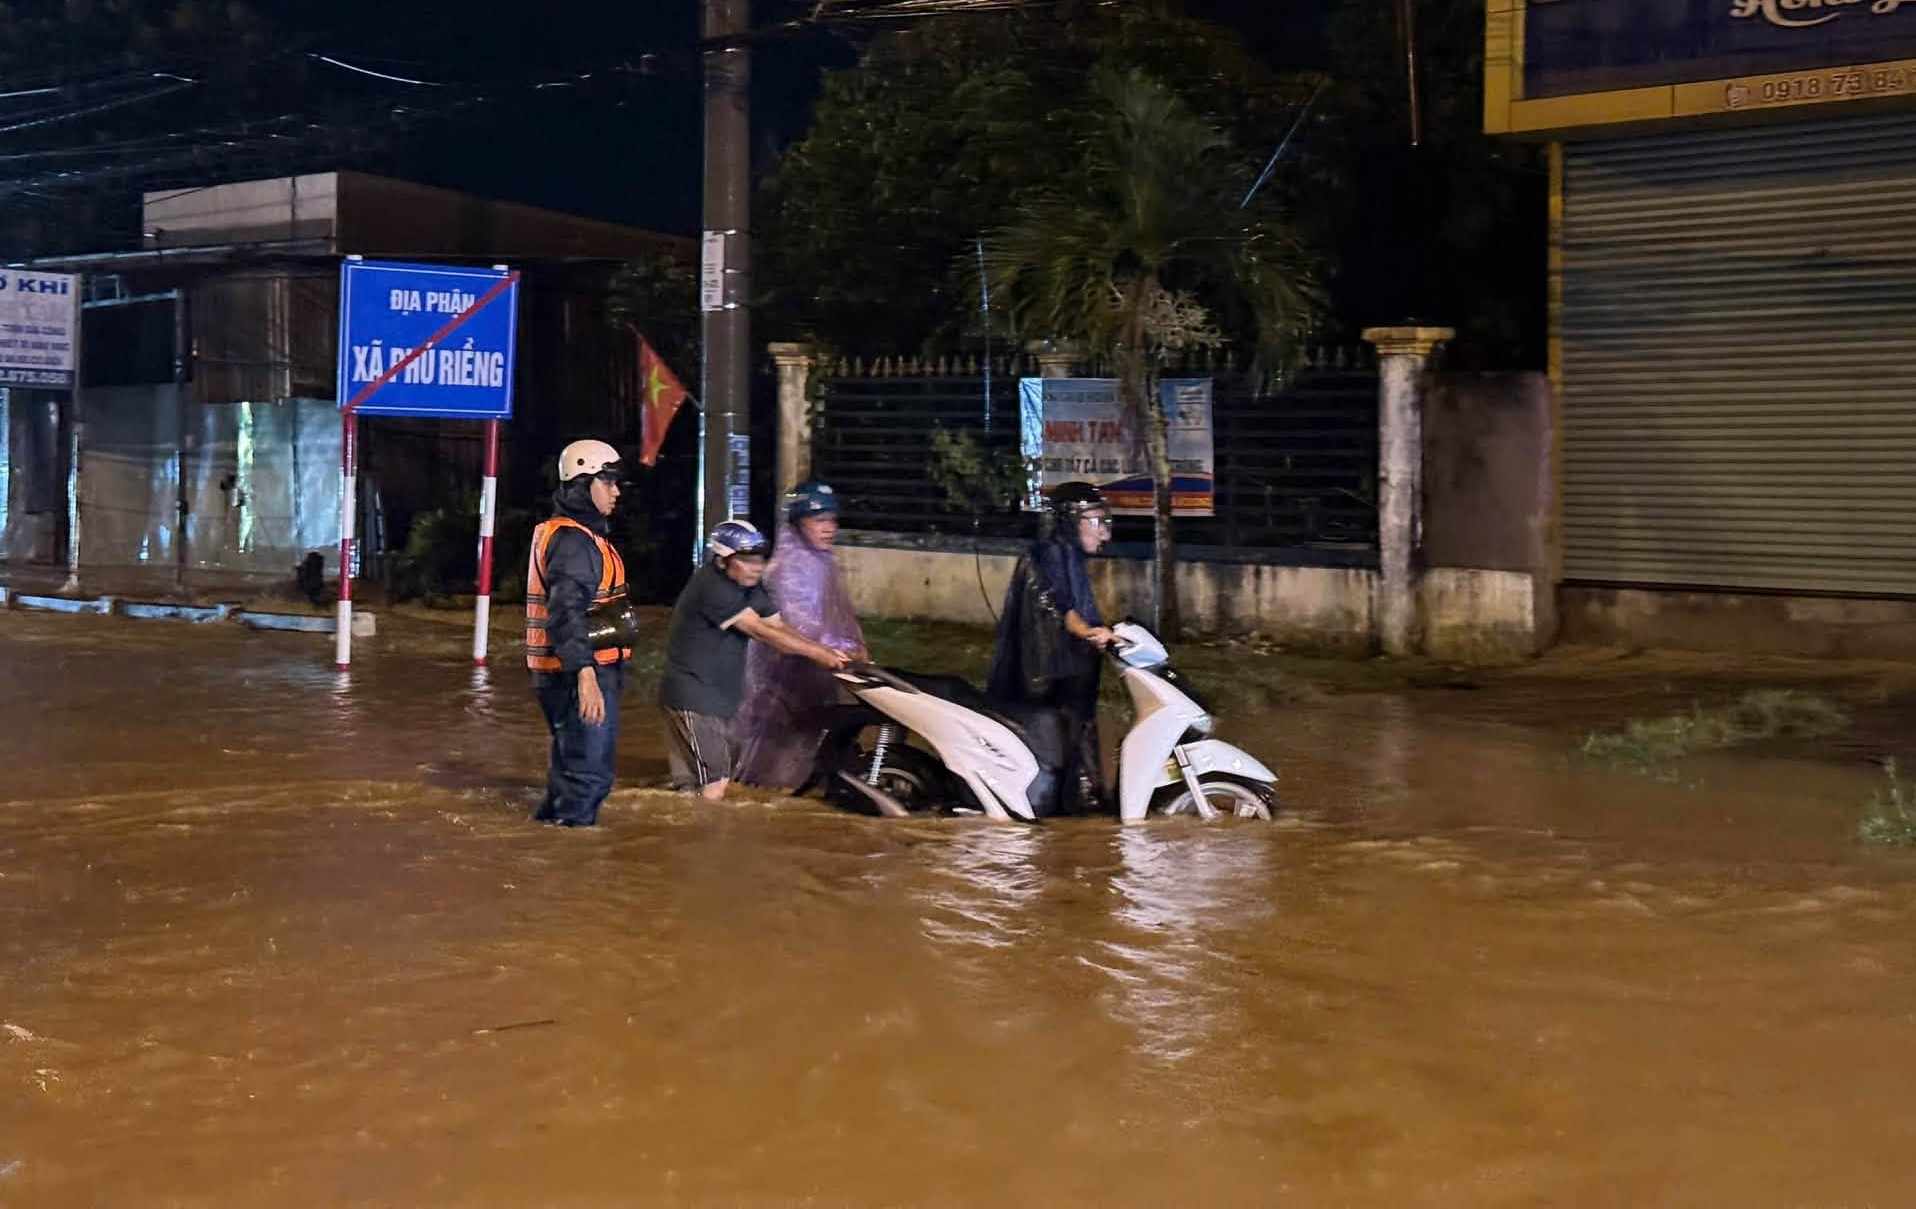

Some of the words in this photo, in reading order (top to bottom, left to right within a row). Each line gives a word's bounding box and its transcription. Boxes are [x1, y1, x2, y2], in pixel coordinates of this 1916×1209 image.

[1762, 78, 1820, 99] 0918
[390, 289, 421, 316] ĐỊA
[425, 288, 476, 319] PHẬN
[352, 339, 384, 382] XÃ
